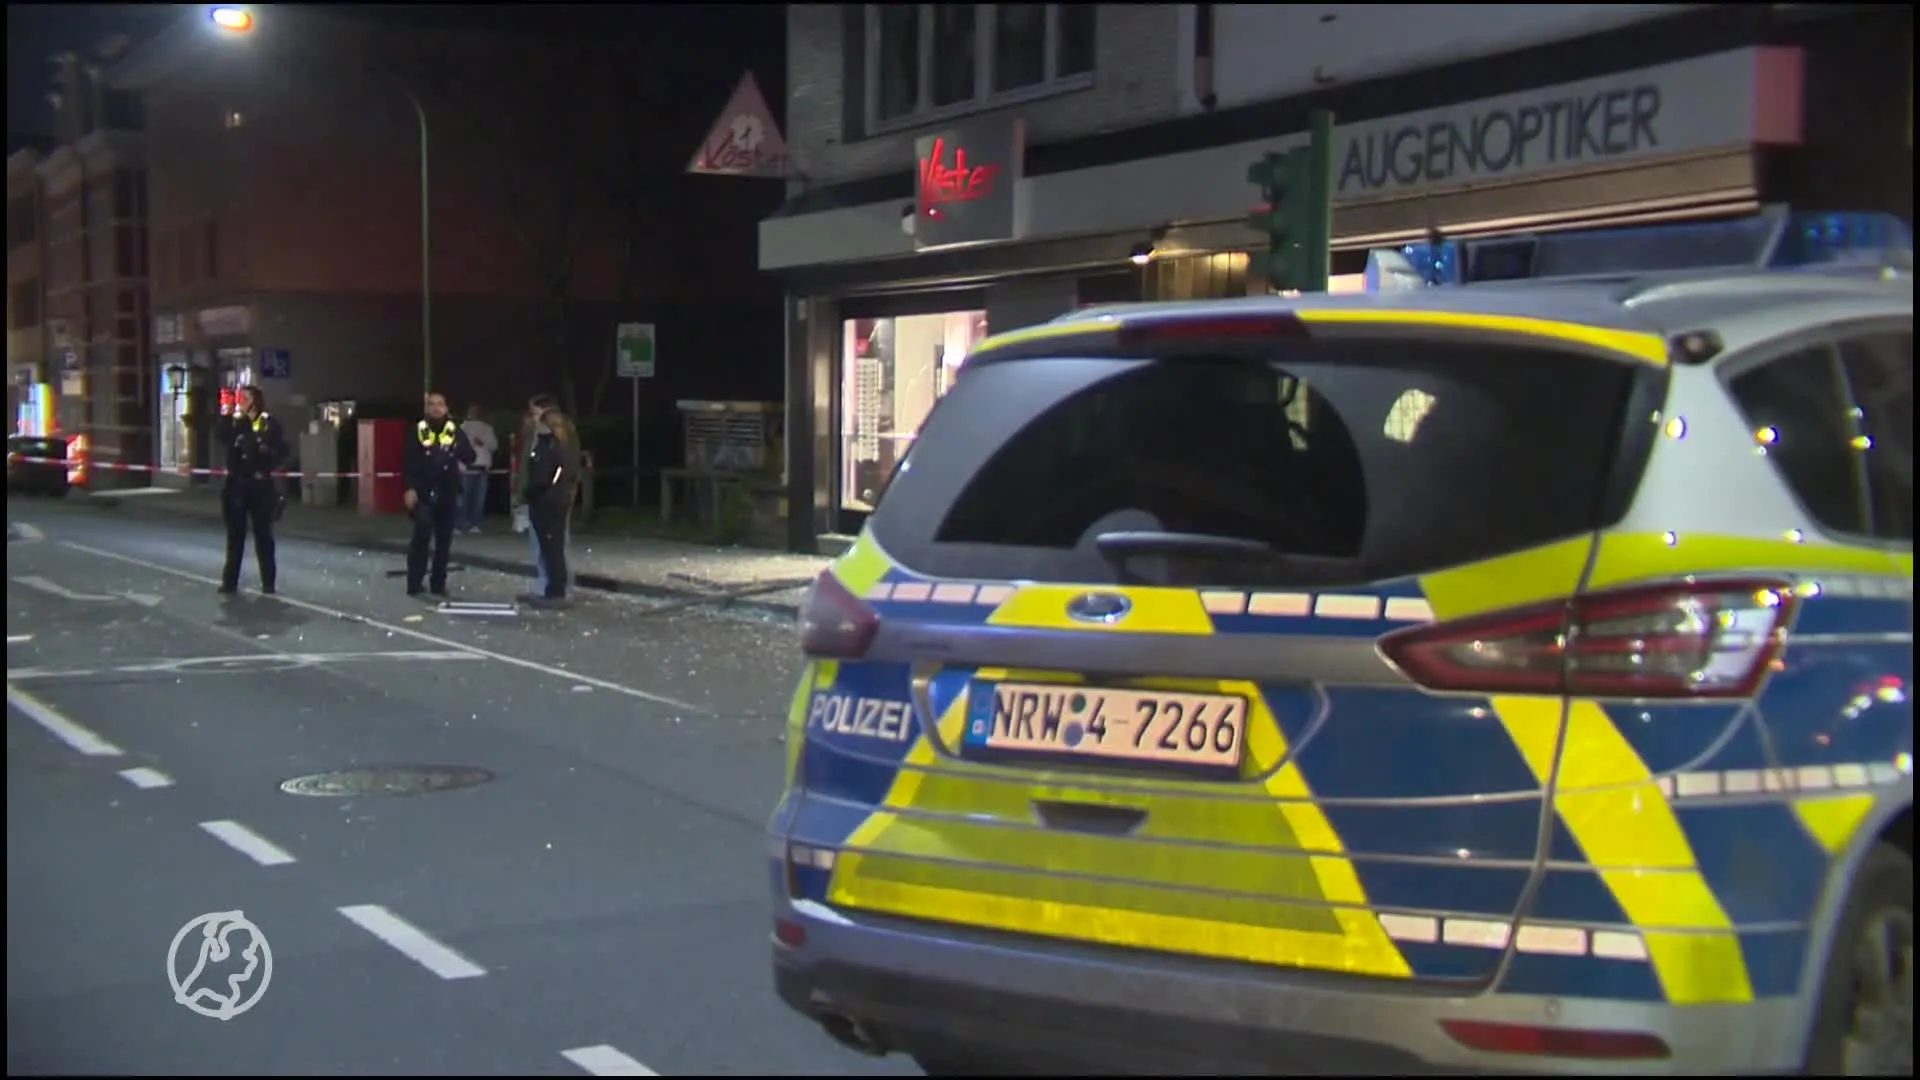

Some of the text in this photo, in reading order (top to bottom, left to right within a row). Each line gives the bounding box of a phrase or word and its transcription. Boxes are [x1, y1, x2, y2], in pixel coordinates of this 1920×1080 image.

[1338, 86, 1661, 191] AUGENOPTIKER
[808, 694, 912, 741] POLIZEI
[991, 690, 1063, 743] NRW
